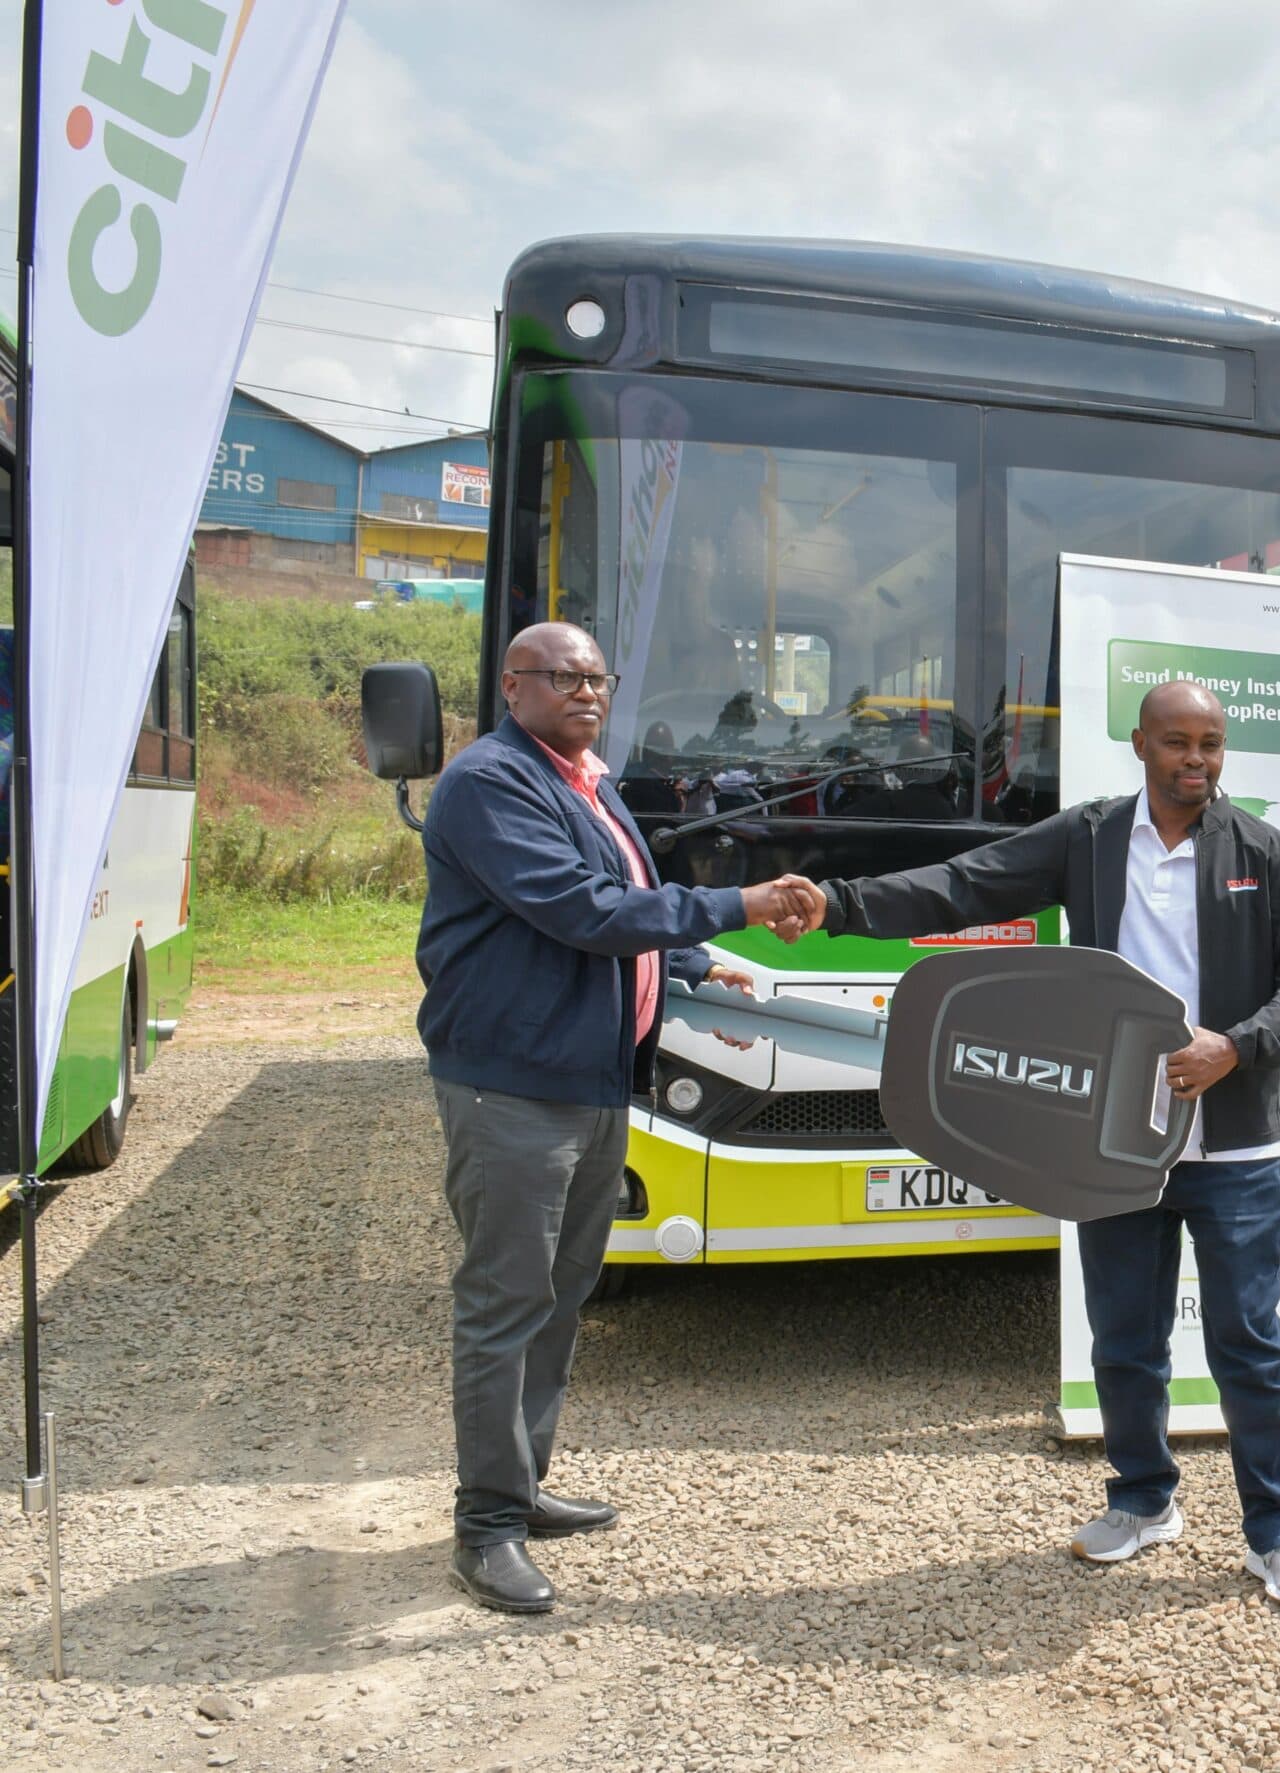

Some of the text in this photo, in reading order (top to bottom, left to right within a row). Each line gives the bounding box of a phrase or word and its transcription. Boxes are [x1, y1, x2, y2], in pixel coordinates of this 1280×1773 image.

[1120, 665, 1170, 684] Send
[953, 1043, 1094, 1098] ISUZU
[900, 1168, 968, 1207] KDQ
